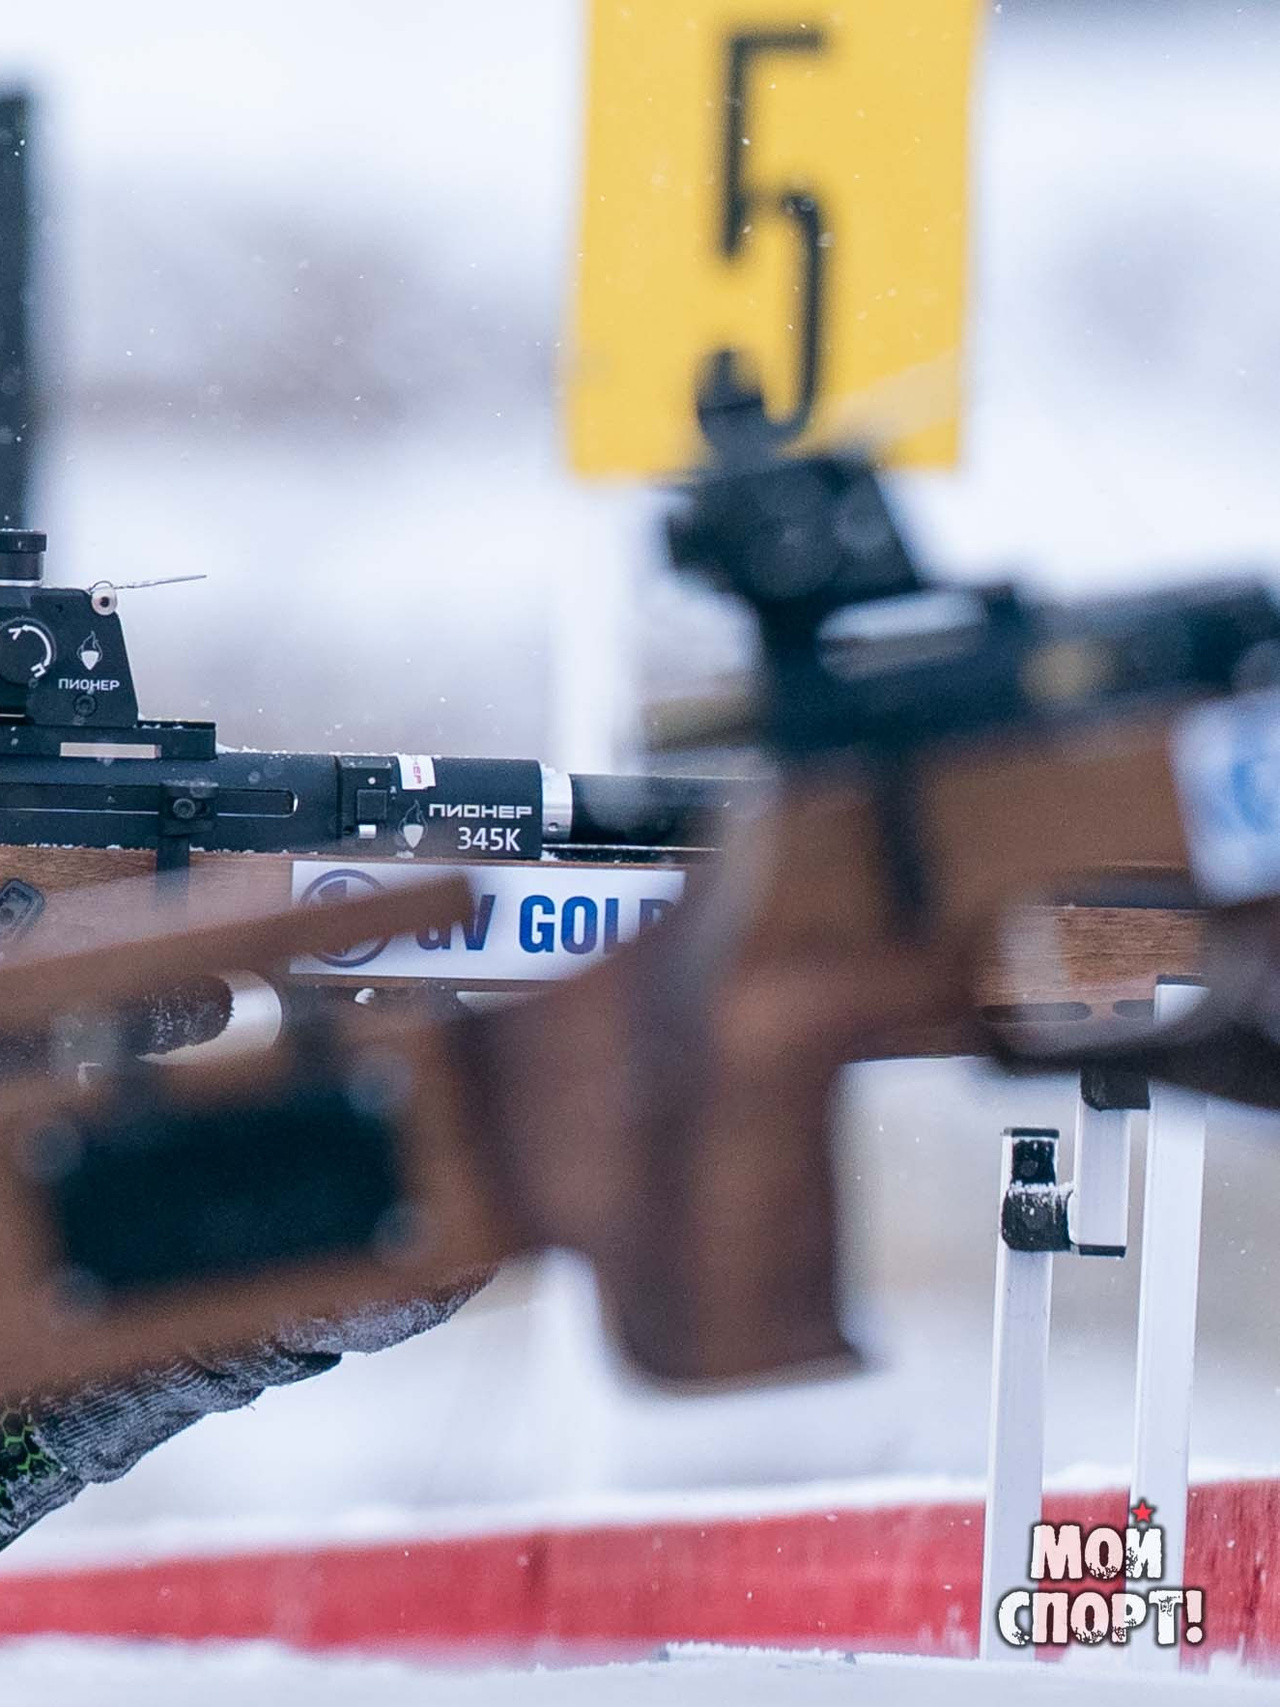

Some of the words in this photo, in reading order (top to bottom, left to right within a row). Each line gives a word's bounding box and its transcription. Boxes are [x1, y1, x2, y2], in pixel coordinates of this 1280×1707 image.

[722, 31, 829, 441] 5
[58, 677, 120, 691] ПИОНЕР
[428, 803, 533, 819] ПИОНЕР
